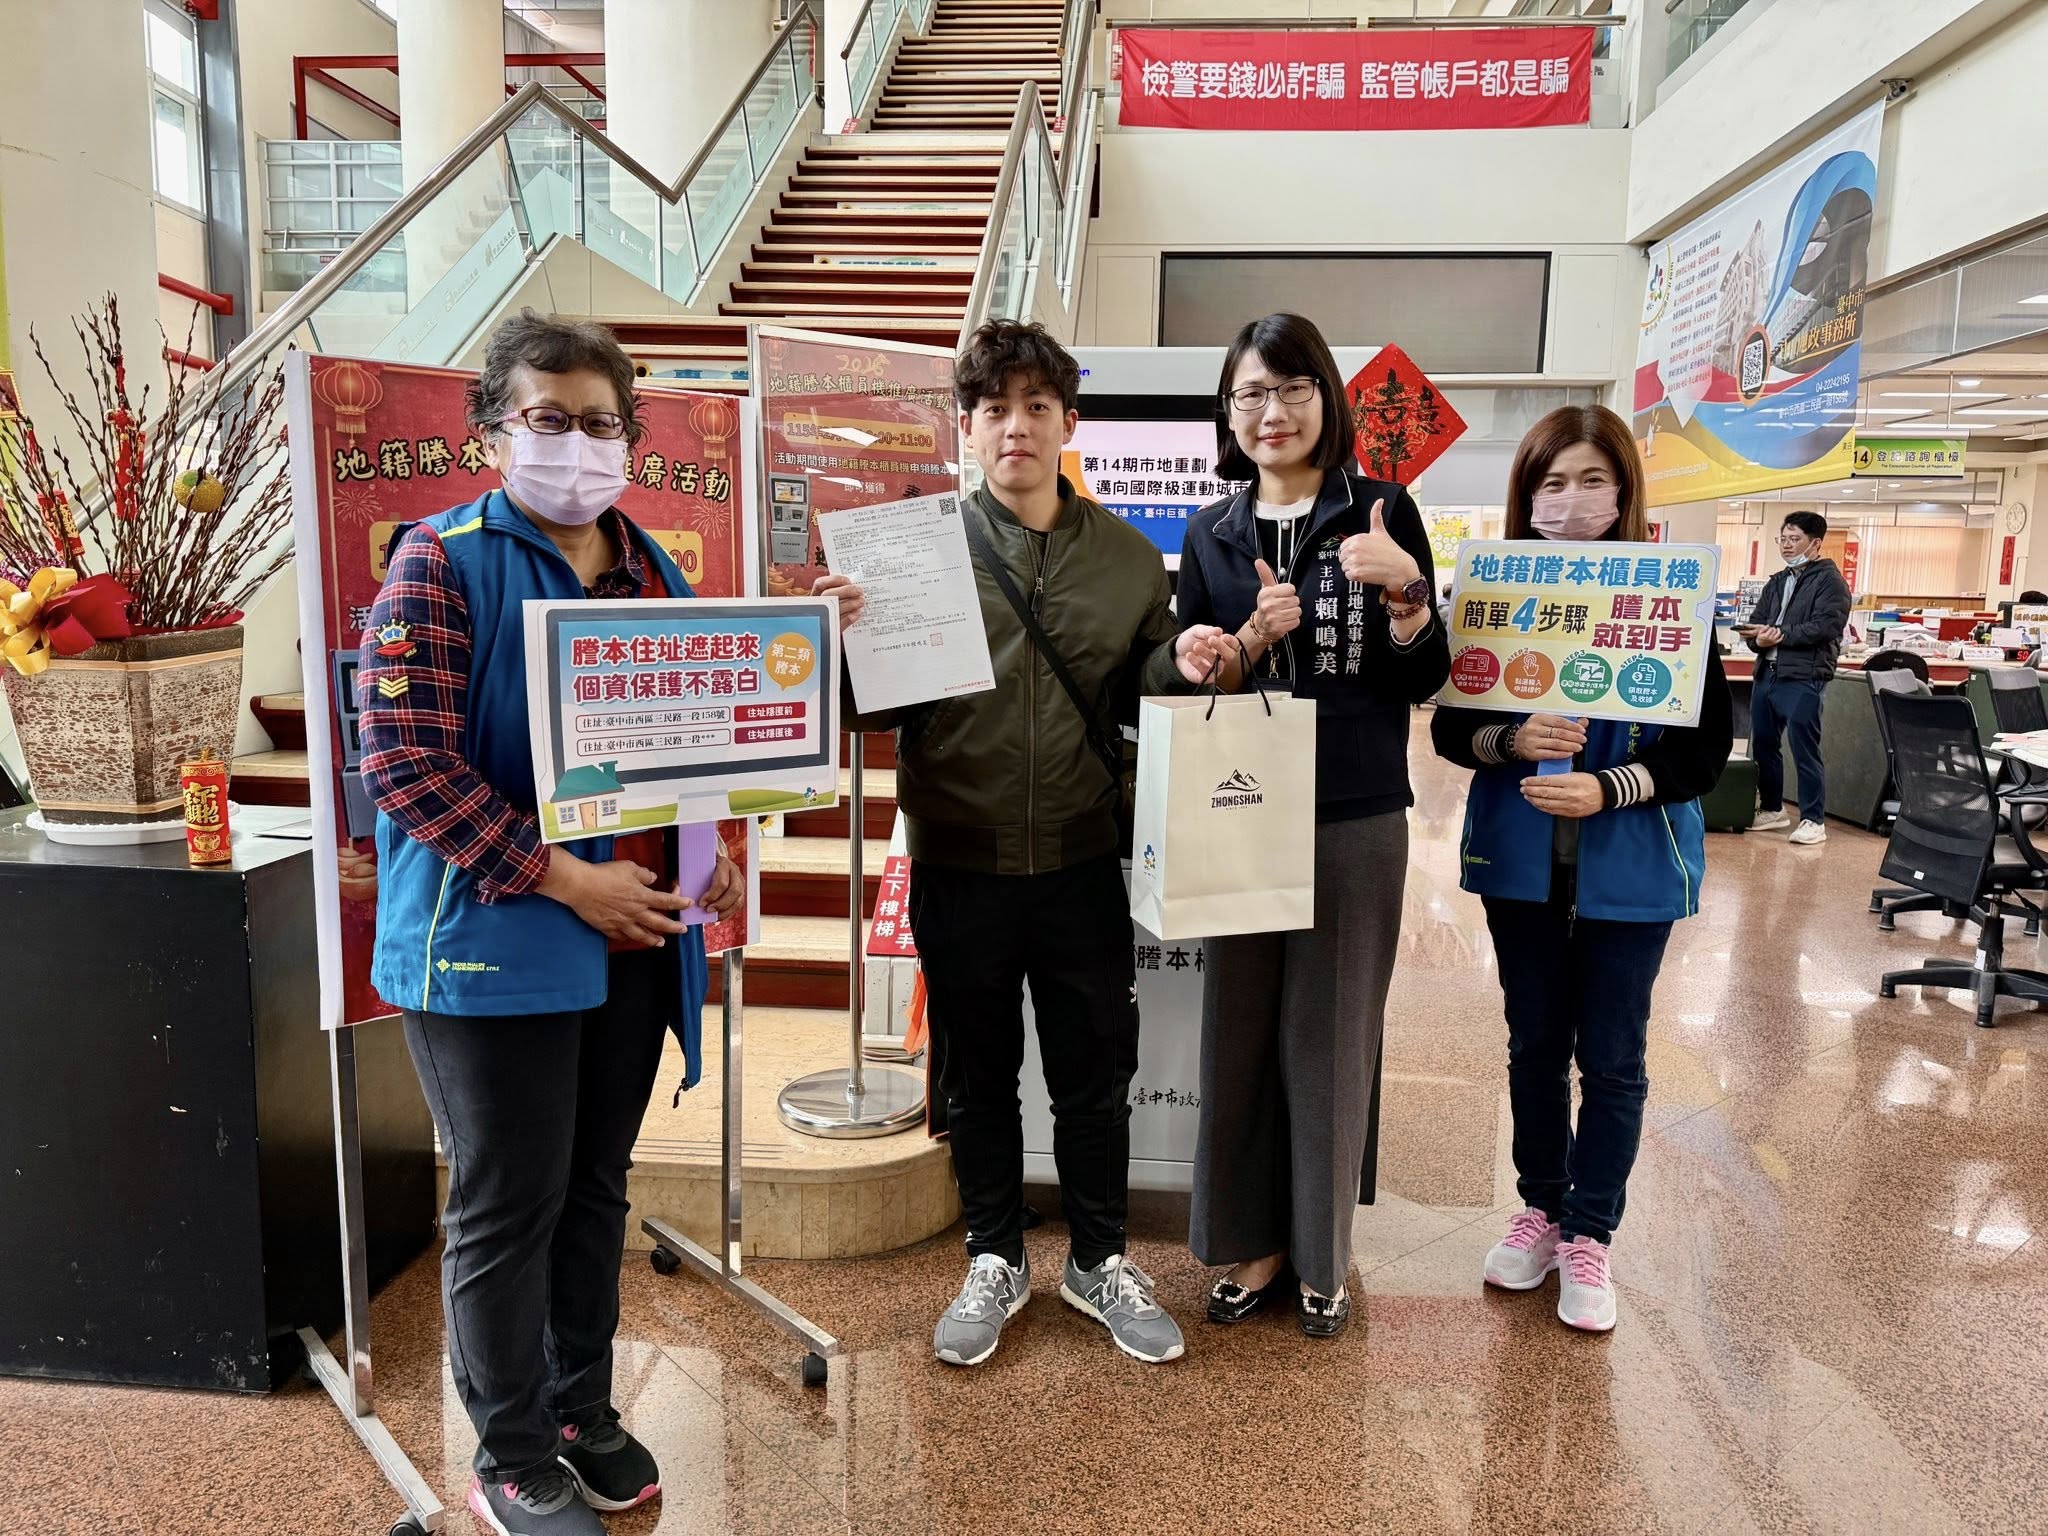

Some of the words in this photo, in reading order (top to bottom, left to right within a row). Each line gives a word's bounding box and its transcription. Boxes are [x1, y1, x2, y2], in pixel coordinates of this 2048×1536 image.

[1142, 59, 1346, 100] 檢警要錢必詐騙
[1360, 57, 1569, 99] 監管帳戶都是騙
[769, 374, 950, 411] 地籍謄本櫃員機推廣活動
[774, 451, 950, 476] 活動期間使用地籍謄本櫃員機申領謄本
[1084, 457, 1207, 473] 第14期市地重劃
[1854, 451, 1868, 464] 14
[1096, 480, 1249, 497] 邁向國際級運動城市
[1145, 508, 1187, 518] 臺中巨蛋
[1319, 565, 1334, 593] 主任
[1469, 553, 1702, 591] 地籍謄本櫃員機
[1462, 596, 1590, 635] 簡單4步驟
[1610, 594, 1682, 622] 謄本
[1314, 597, 1339, 675] 賴鳴美
[1591, 622, 1692, 652] 就到手
[571, 633, 761, 667] 謄本住址遮起來
[771, 642, 810, 662] 第二類
[1563, 650, 1585, 665] STEP3
[1620, 653, 1643, 668] STEP4
[774, 661, 801, 676] 謄本
[572, 667, 760, 704] 個資保護不露白
[747, 706, 793, 718] 住址隱匿前
[747, 727, 794, 740] 住址隱匿後
[1211, 793, 1263, 809] ZHONGSHAN
[875, 861, 906, 937] 上下樓梯
